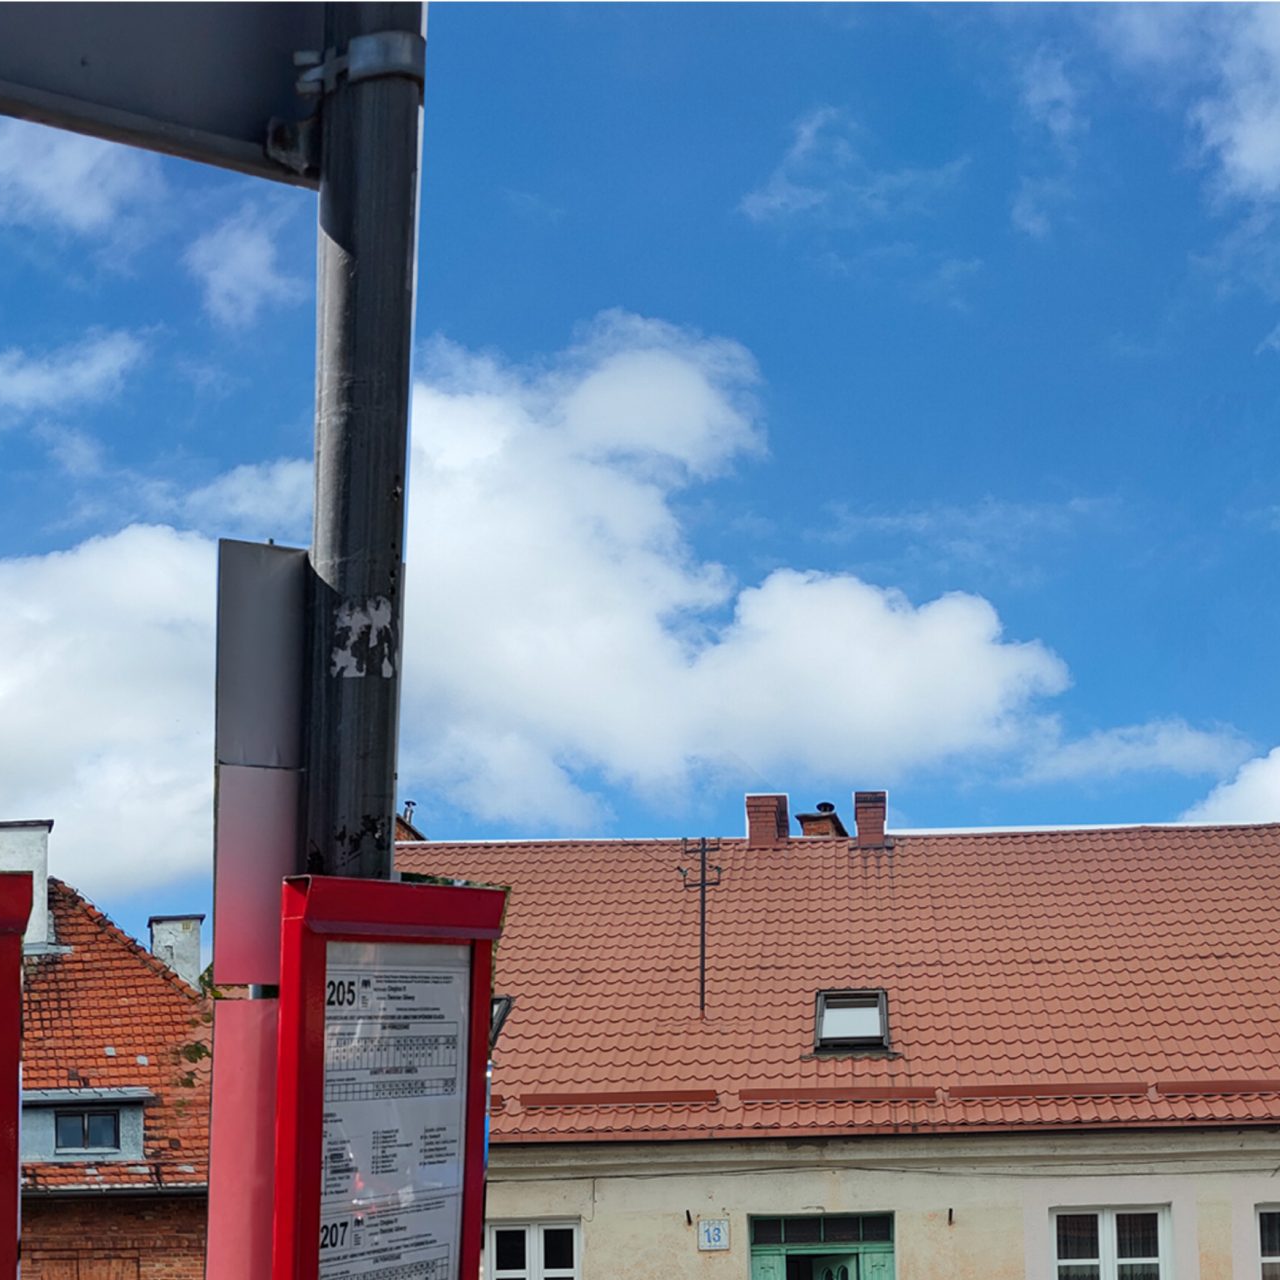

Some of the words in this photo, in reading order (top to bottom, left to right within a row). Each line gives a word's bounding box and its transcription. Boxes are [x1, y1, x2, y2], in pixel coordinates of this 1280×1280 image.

[326, 980, 356, 1006] 205
[321, 1222, 348, 1249] 207
[704, 1227, 721, 1243] 13
